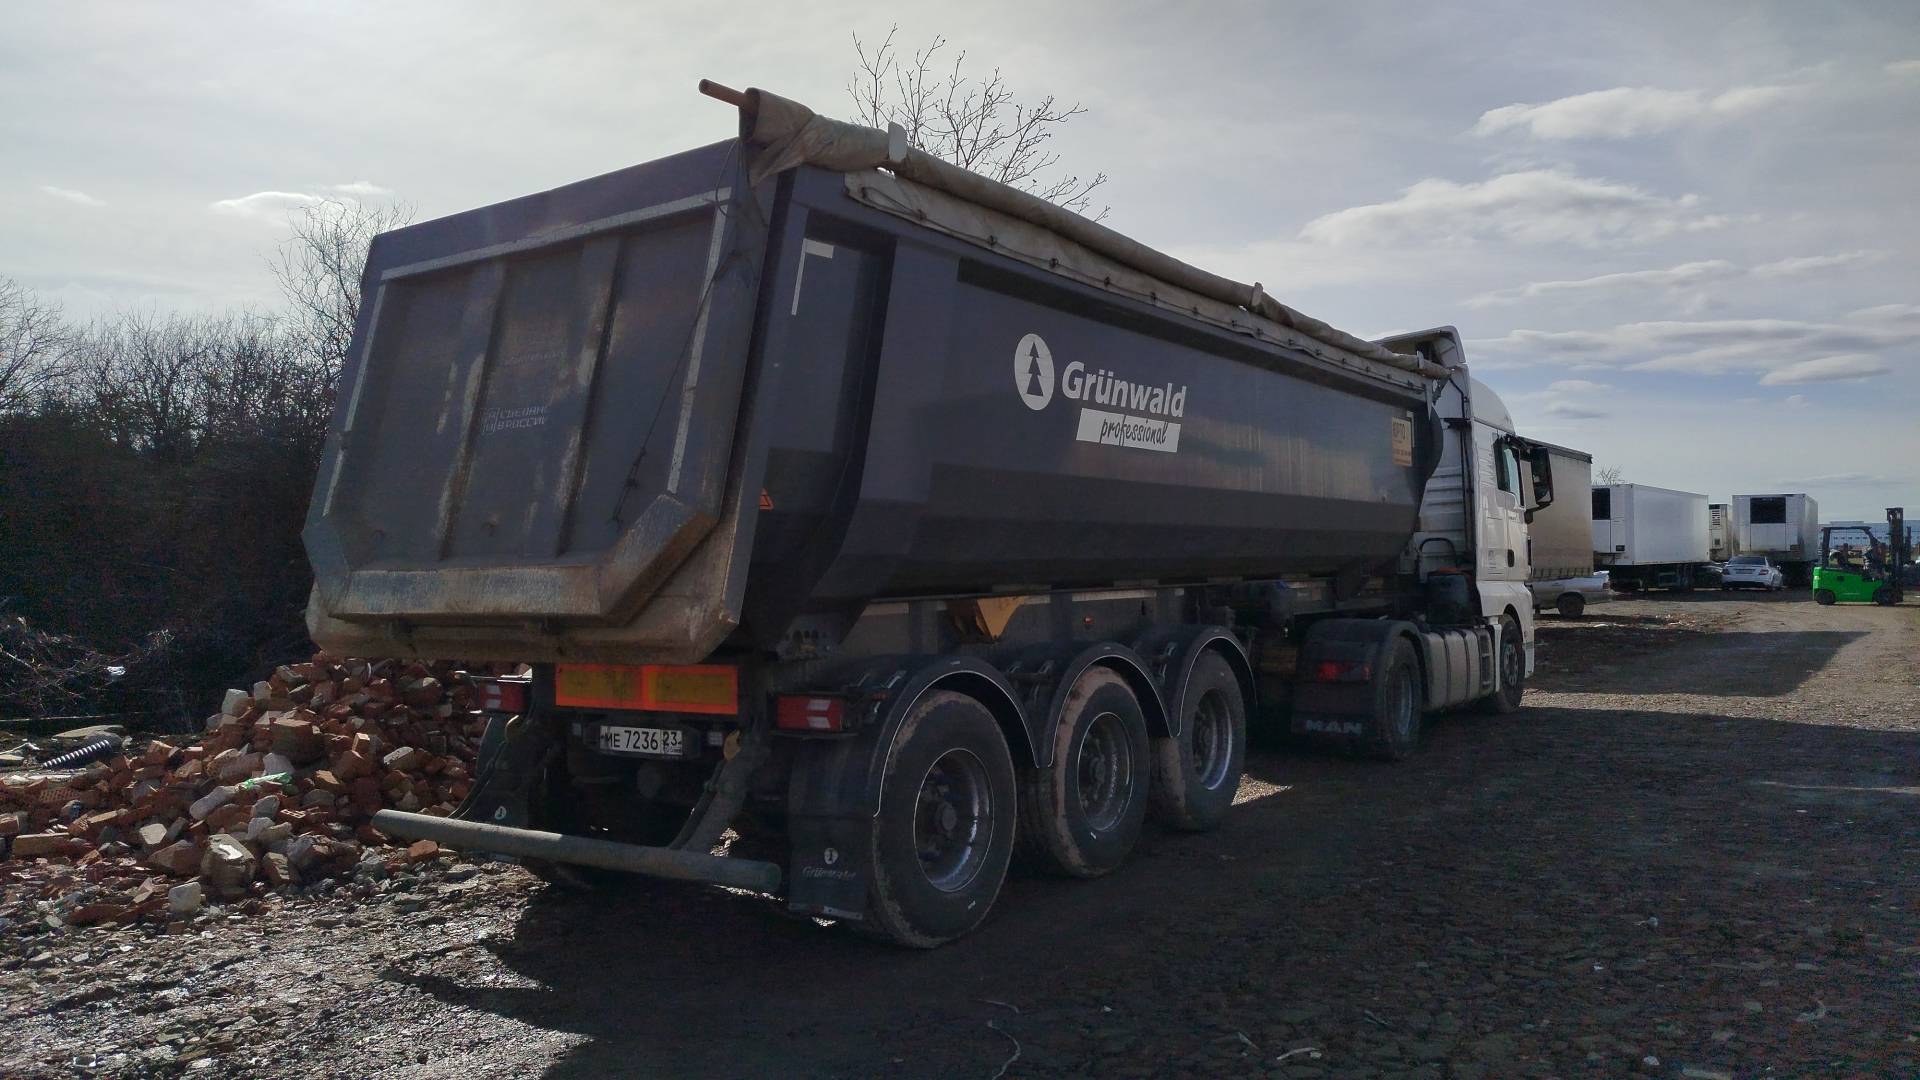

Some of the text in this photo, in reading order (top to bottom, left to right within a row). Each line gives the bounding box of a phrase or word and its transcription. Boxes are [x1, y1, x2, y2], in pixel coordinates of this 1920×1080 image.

[1062, 361, 1187, 418] Grünwald
[1099, 414, 1169, 447] professional
[624, 730, 659, 750] 7236
[662, 731, 678, 746] 23
[1306, 719, 1362, 735] MAN
